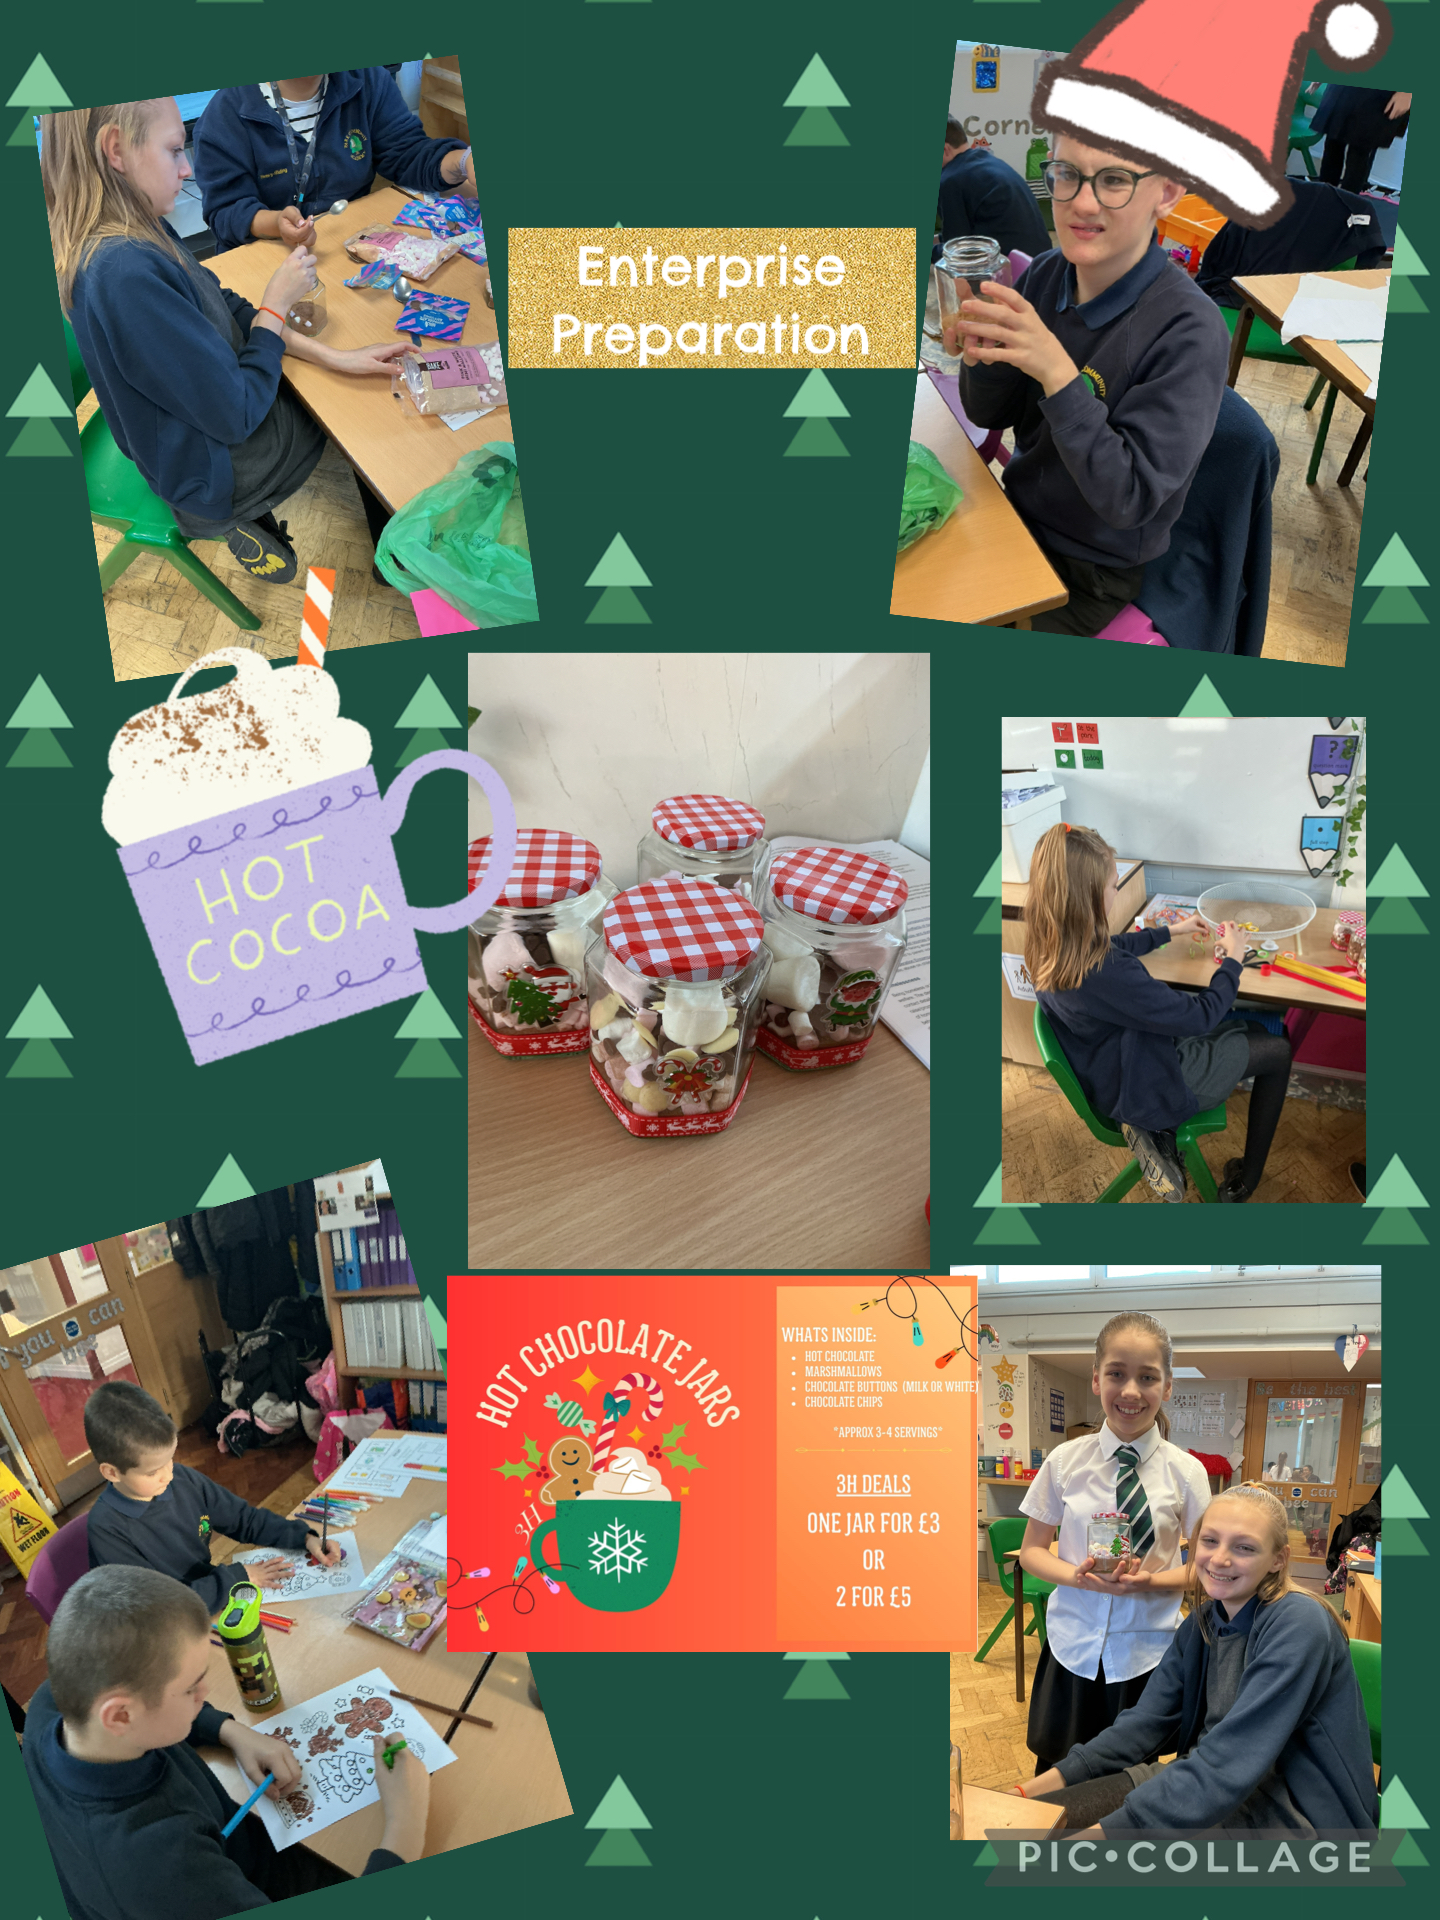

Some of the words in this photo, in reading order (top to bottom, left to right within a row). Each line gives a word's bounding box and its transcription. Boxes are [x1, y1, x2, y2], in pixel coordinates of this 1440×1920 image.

[963, 115, 1053, 137] Corne
[425, 361, 441, 370] BAKE
[1313, 762, 1334, 770] question
[88, 1297, 125, 1325] can
[781, 1326, 828, 1342] WHATS
[832, 1326, 876, 1342] INSIDE:
[805, 1350, 822, 1362] HOT
[825, 1350, 875, 1362] CHOCOLATE
[475, 1363, 528, 1428] HOT
[519, 1318, 692, 1377] CHOCOLATE
[674, 1357, 741, 1428] JARS
[805, 1366, 882, 1377] MARSHMALLOWS
[805, 1381, 855, 1392] CHOCOLATE
[857, 1381, 898, 1392] BUTTONS
[902, 1380, 928, 1394] (MILK
[930, 1381, 942, 1392] OR
[945, 1380, 979, 1394] WHITE)
[1256, 1382, 1274, 1396] Be
[1290, 1382, 1317, 1396] the
[1324, 1382, 1357, 1396] best
[805, 1396, 855, 1408] CHOCOLATE
[857, 1396, 883, 1408] CHIPS
[875, 1426, 893, 1438] 3-4
[836, 1474, 857, 1494] 3H
[862, 1474, 911, 1494] DEALS
[0, 1488, 21, 1510] UTION
[1310, 1487, 1338, 1498] can
[1284, 1497, 1310, 1508] bee
[514, 1502, 544, 1546] 3H
[807, 1512, 841, 1534] ONE
[844, 1512, 875, 1537] JAR
[880, 1512, 913, 1534] FOR
[918, 1512, 940, 1535] £3
[17, 1540, 33, 1553] WET
[30, 1526, 50, 1544] FLOOR
[863, 1549, 885, 1571] OR
[836, 1585, 846, 1607] 2
[851, 1586, 885, 1607] FOR
[890, 1585, 911, 1608] £5
